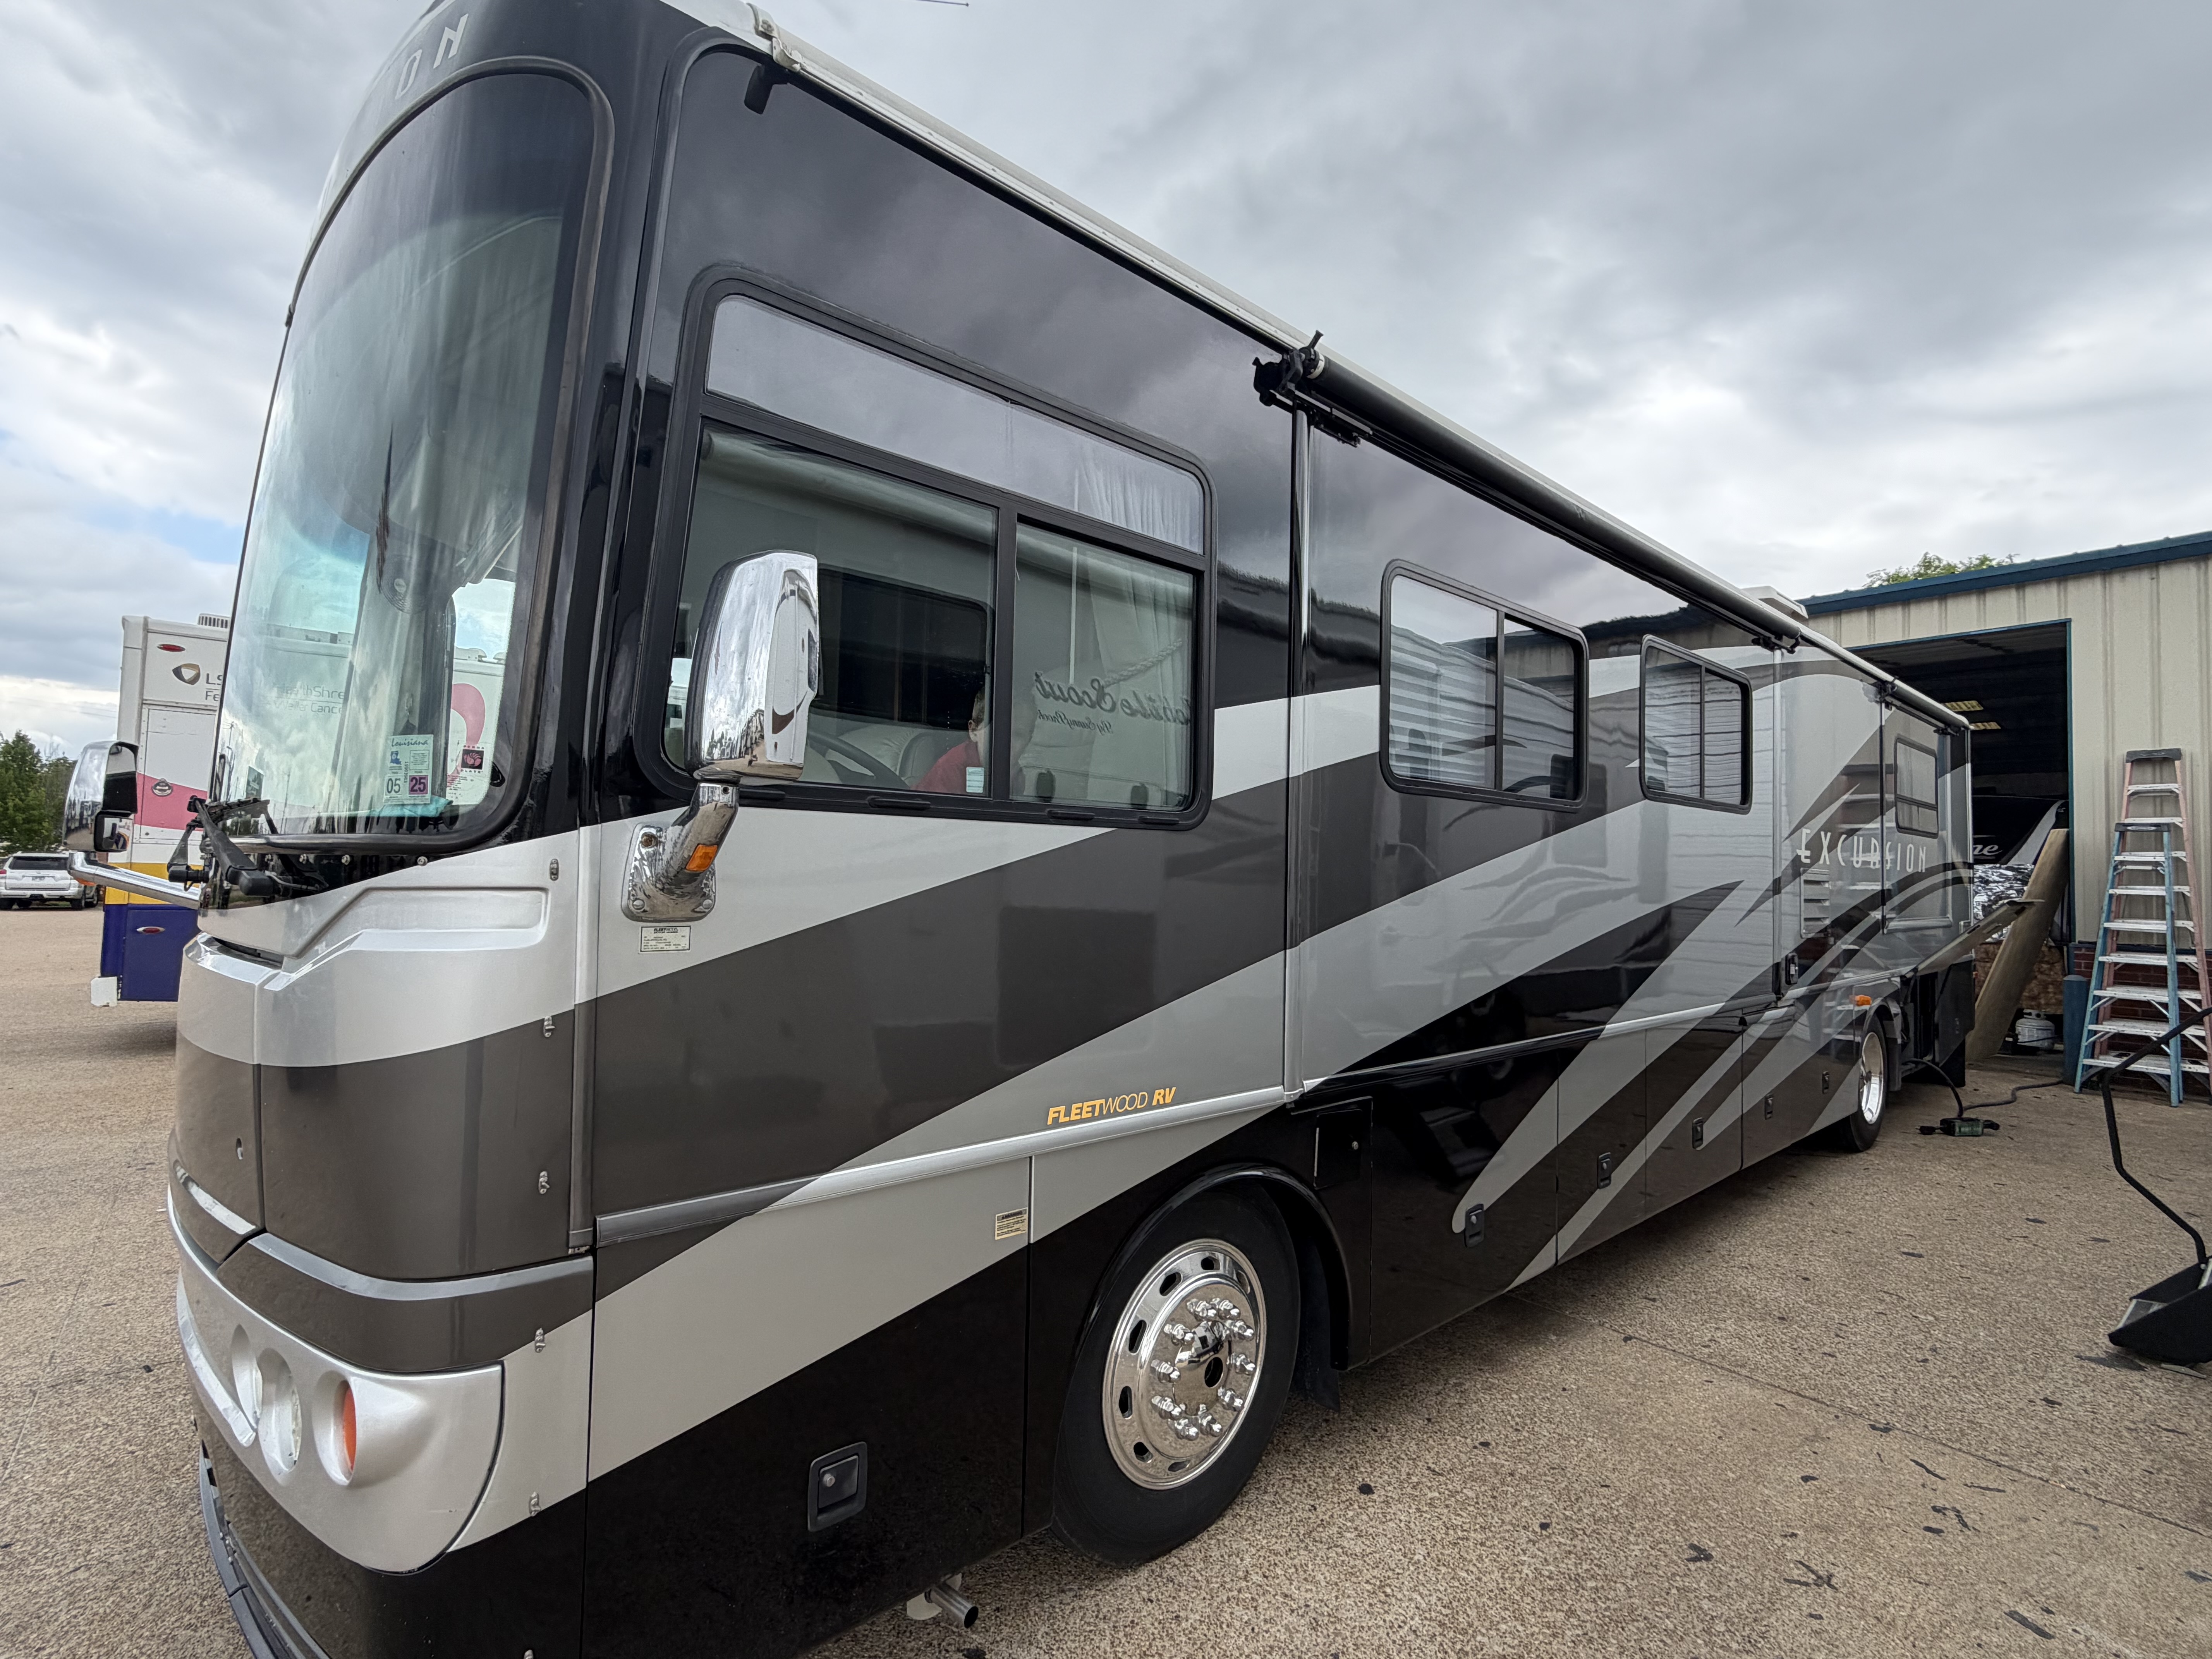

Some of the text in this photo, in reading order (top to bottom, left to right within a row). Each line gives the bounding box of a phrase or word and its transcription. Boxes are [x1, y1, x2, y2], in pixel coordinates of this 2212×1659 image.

[392, 738, 428, 747] Louisiana
[387, 778, 400, 793] 05
[410, 777, 426, 792] 25
[1047, 1087, 1176, 1125] FLEETWOOD RV
